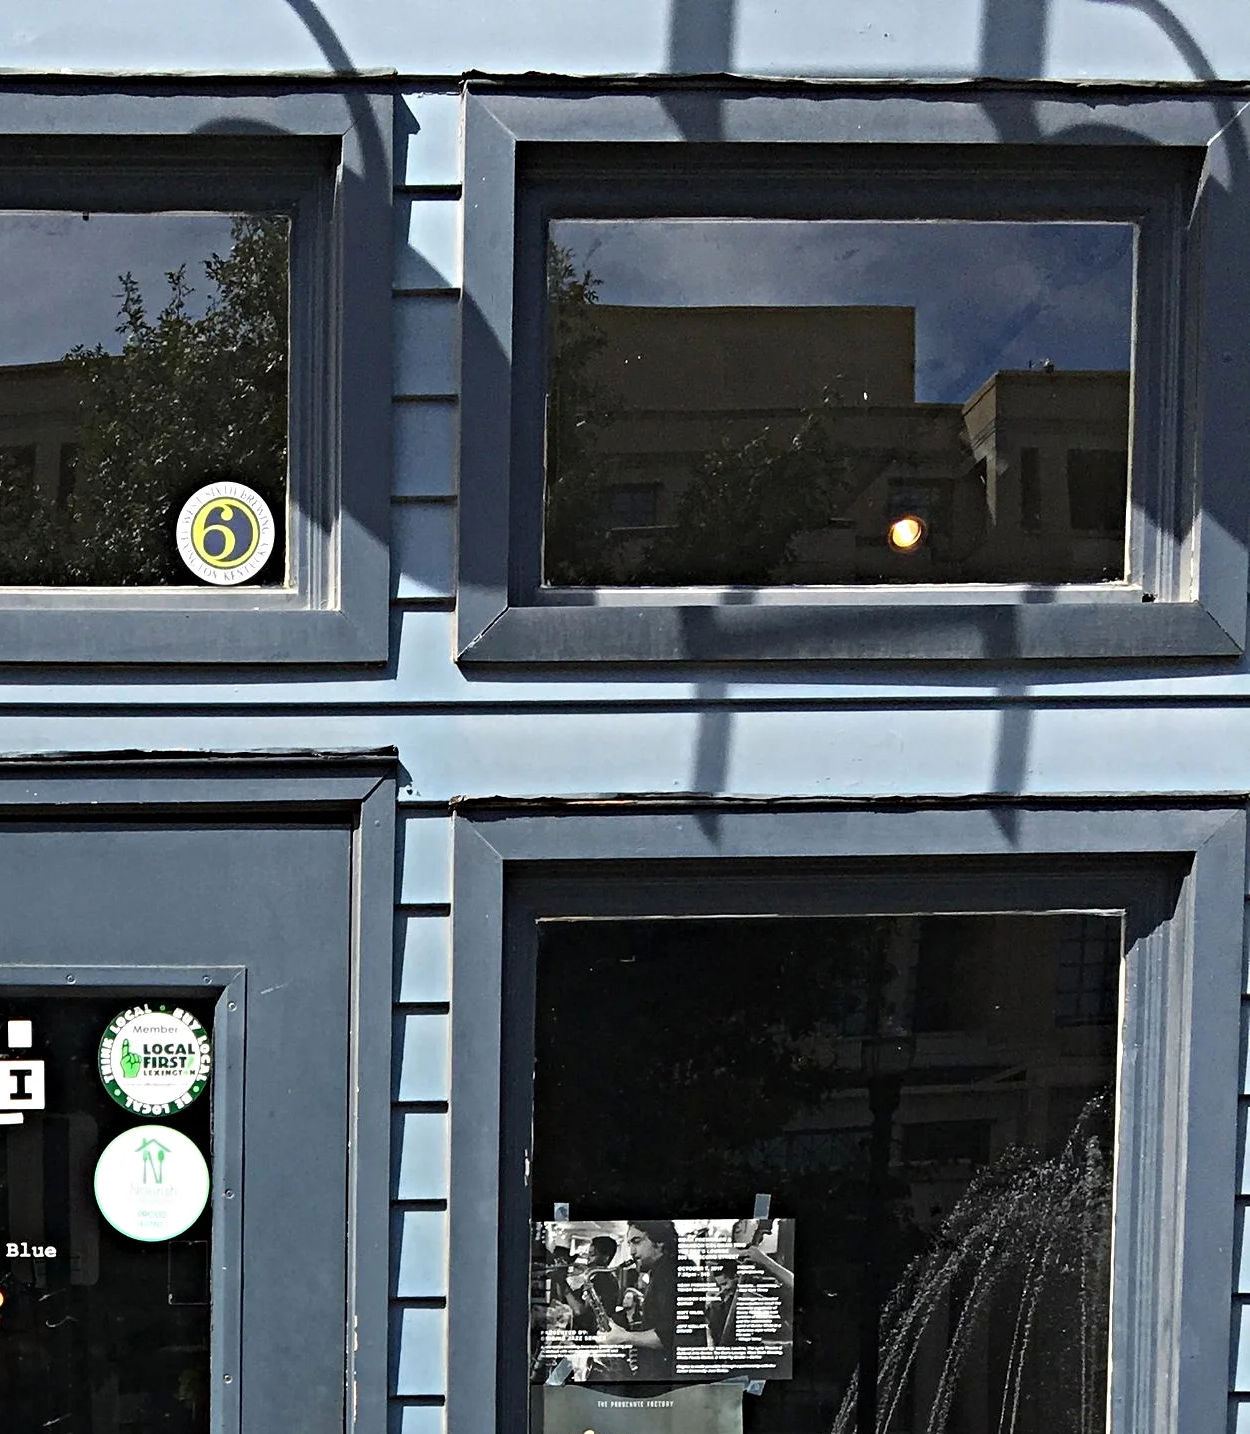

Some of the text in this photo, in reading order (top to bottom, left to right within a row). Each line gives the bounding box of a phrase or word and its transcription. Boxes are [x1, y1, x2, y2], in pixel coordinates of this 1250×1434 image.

[192, 501, 244, 565] 6
[132, 1025, 178, 1034] Member
[100, 1003, 152, 1084] THINK LOCAL
[143, 1043, 196, 1055] LOCAL
[172, 1008, 210, 1082] BUY LOCAL
[124, 1094, 194, 1116] BE LOCAL
[5, 1242, 58, 1258] Blue
